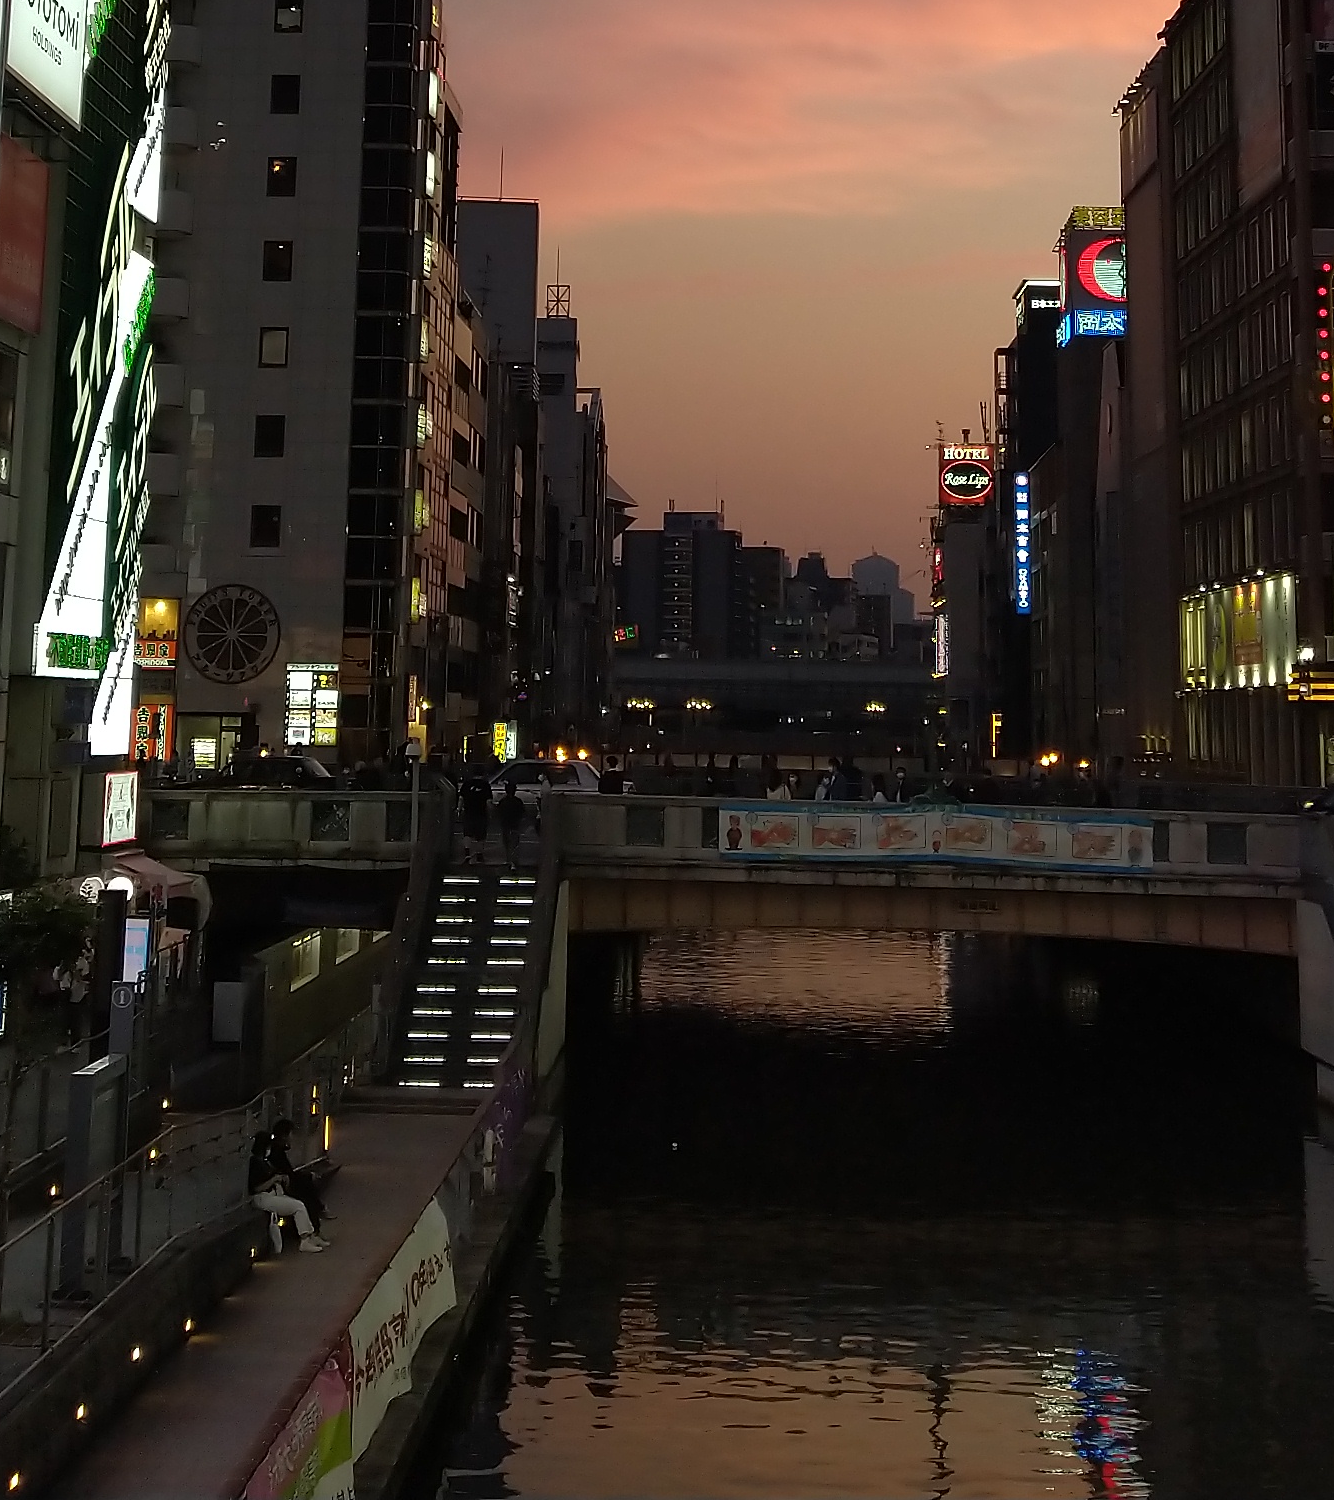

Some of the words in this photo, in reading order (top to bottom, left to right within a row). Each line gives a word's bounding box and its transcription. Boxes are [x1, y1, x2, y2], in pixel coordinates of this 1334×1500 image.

[1077, 312, 1125, 333] 岡本
[943, 447, 990, 461] HOTEL
[943, 473, 967, 486] Rose
[967, 473, 990, 488] Lips
